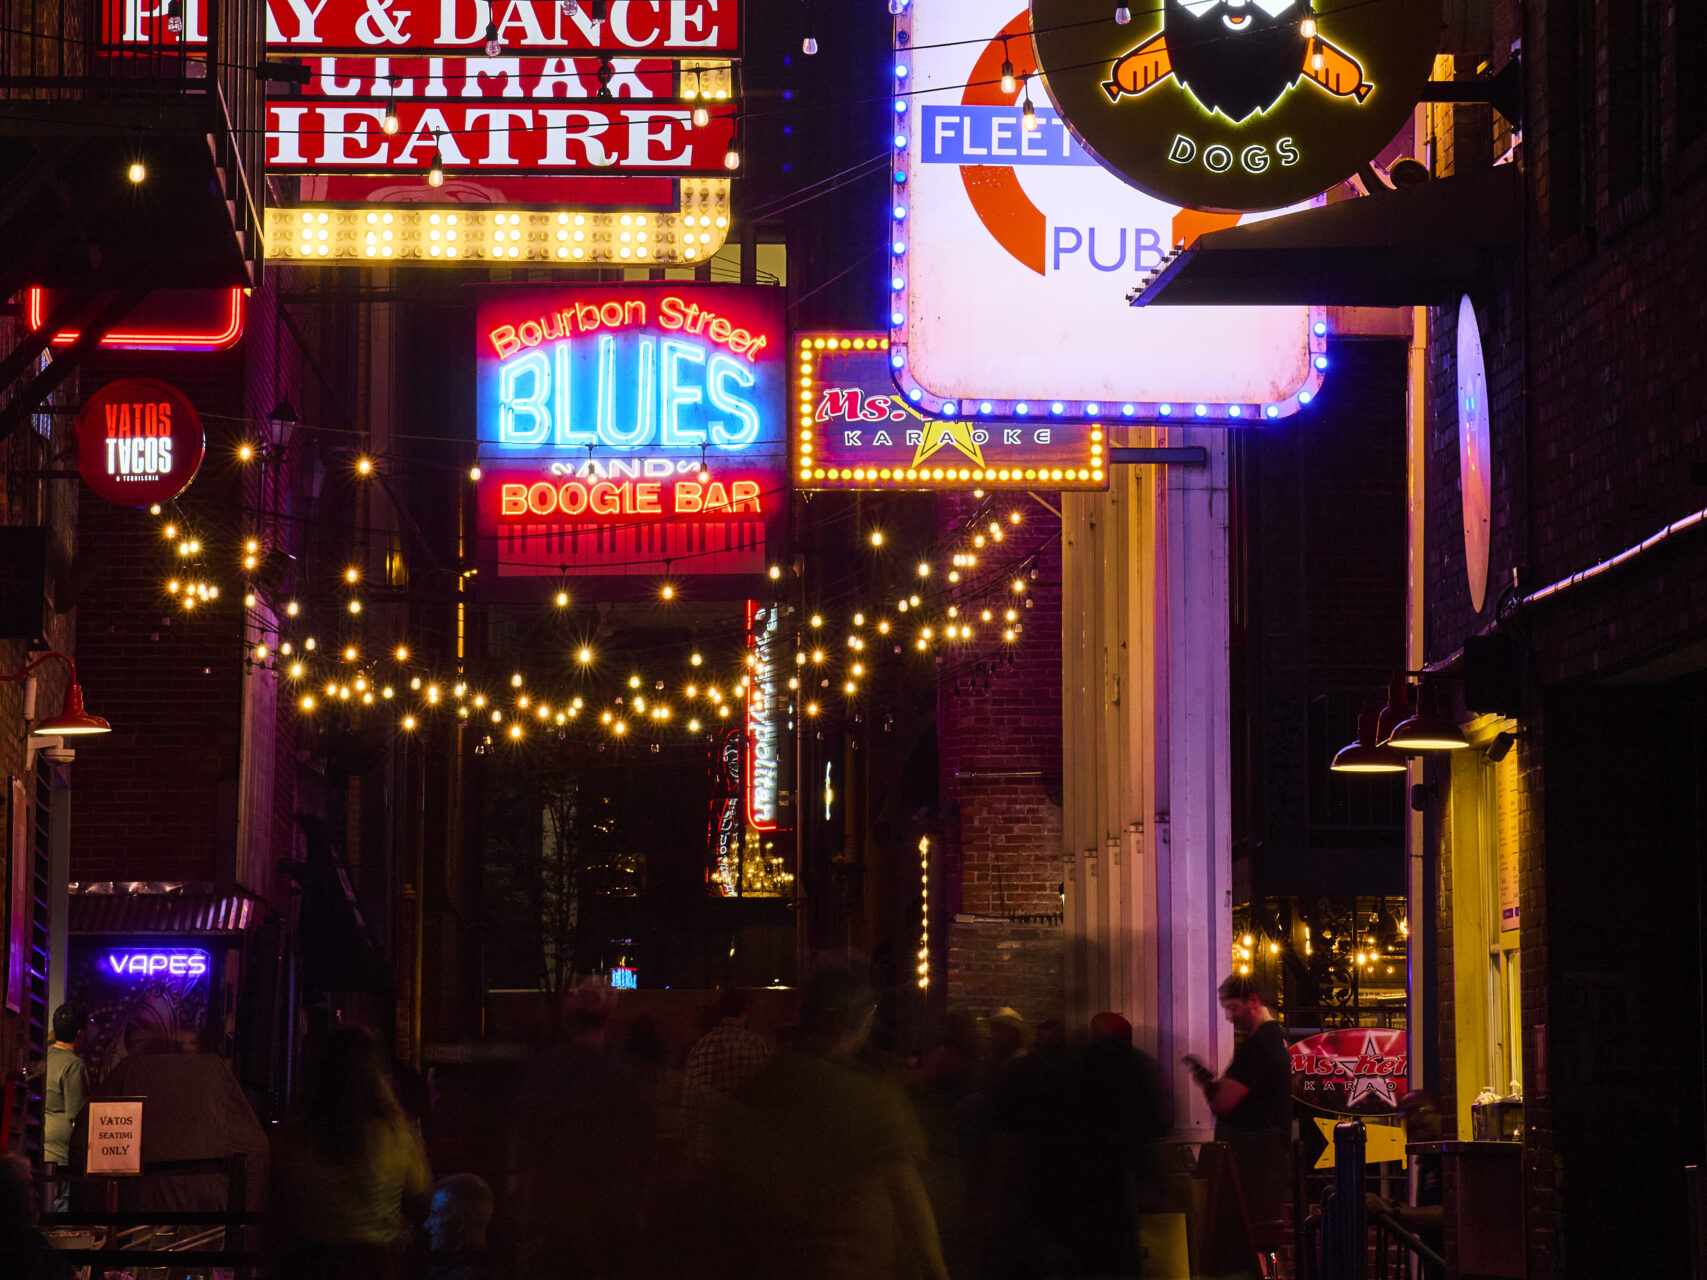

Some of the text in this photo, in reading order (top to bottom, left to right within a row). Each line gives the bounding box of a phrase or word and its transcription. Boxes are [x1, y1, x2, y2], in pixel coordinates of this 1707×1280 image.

[934, 115, 1070, 157] FLEET
[1168, 133, 1300, 174] DOGS
[1053, 226, 1165, 272] PUB
[488, 296, 767, 363] Bourbon Street
[498, 334, 761, 451] BLUES
[815, 387, 906, 422] Ms.
[105, 402, 171, 438] VATOS
[844, 429, 1052, 446] KARAOKE
[105, 436, 172, 475] TACOS
[575, 458, 675, 479] AND
[501, 480, 761, 515] BOOGIE BAR
[109, 953, 206, 975] VAPES
[1290, 1053, 1407, 1076] Ms. Kel
[98, 1131, 133, 1140] SEATING
[100, 1116, 133, 1126] VATOS
[101, 1144, 130, 1156] ONLY
